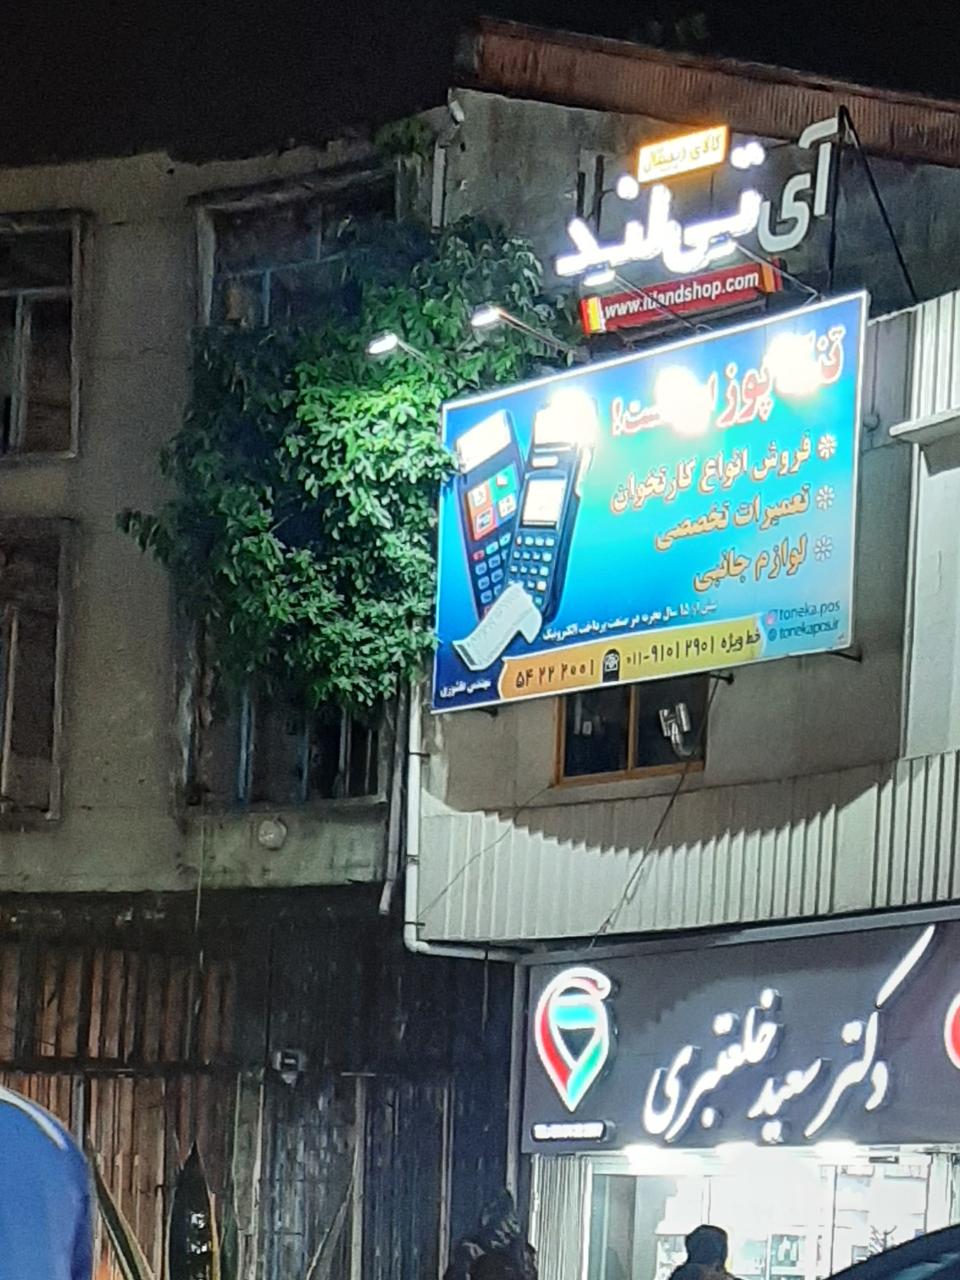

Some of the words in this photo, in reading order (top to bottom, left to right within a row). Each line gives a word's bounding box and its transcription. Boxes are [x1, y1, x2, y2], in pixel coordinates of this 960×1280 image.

[757, 117, 838, 252] آی
[699, 449, 748, 492] انواع
[751, 431, 812, 481] فروش
[611, 456, 696, 515] کارتخوان
[733, 484, 810, 530] تعمیرات
[655, 500, 730, 551] تخصصی
[692, 548, 752, 592] جانبی
[755, 534, 808, 581] لوازم
[745, 628, 761, 645] خط
[804, 923, 936, 1139] دکتر
[747, 1057, 823, 1144] سعید
